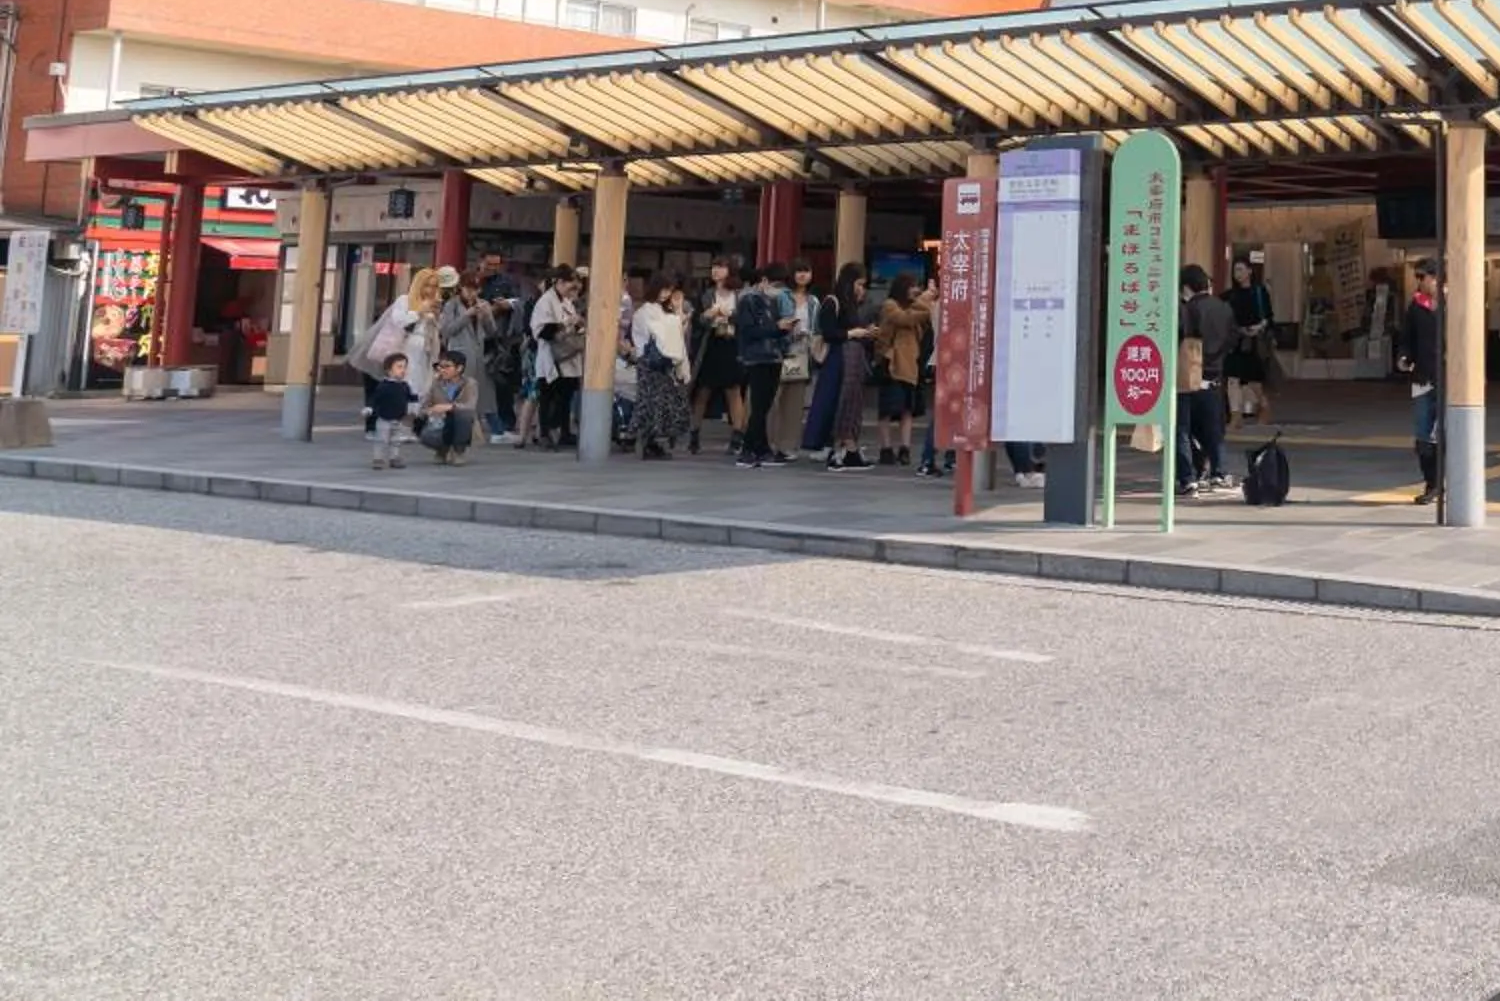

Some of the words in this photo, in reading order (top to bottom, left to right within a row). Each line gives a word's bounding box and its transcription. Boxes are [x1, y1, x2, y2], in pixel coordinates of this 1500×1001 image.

[951, 230, 970, 302] 太宰府
[1120, 367, 1159, 383] 100円
[1127, 385, 1153, 400] 均一
